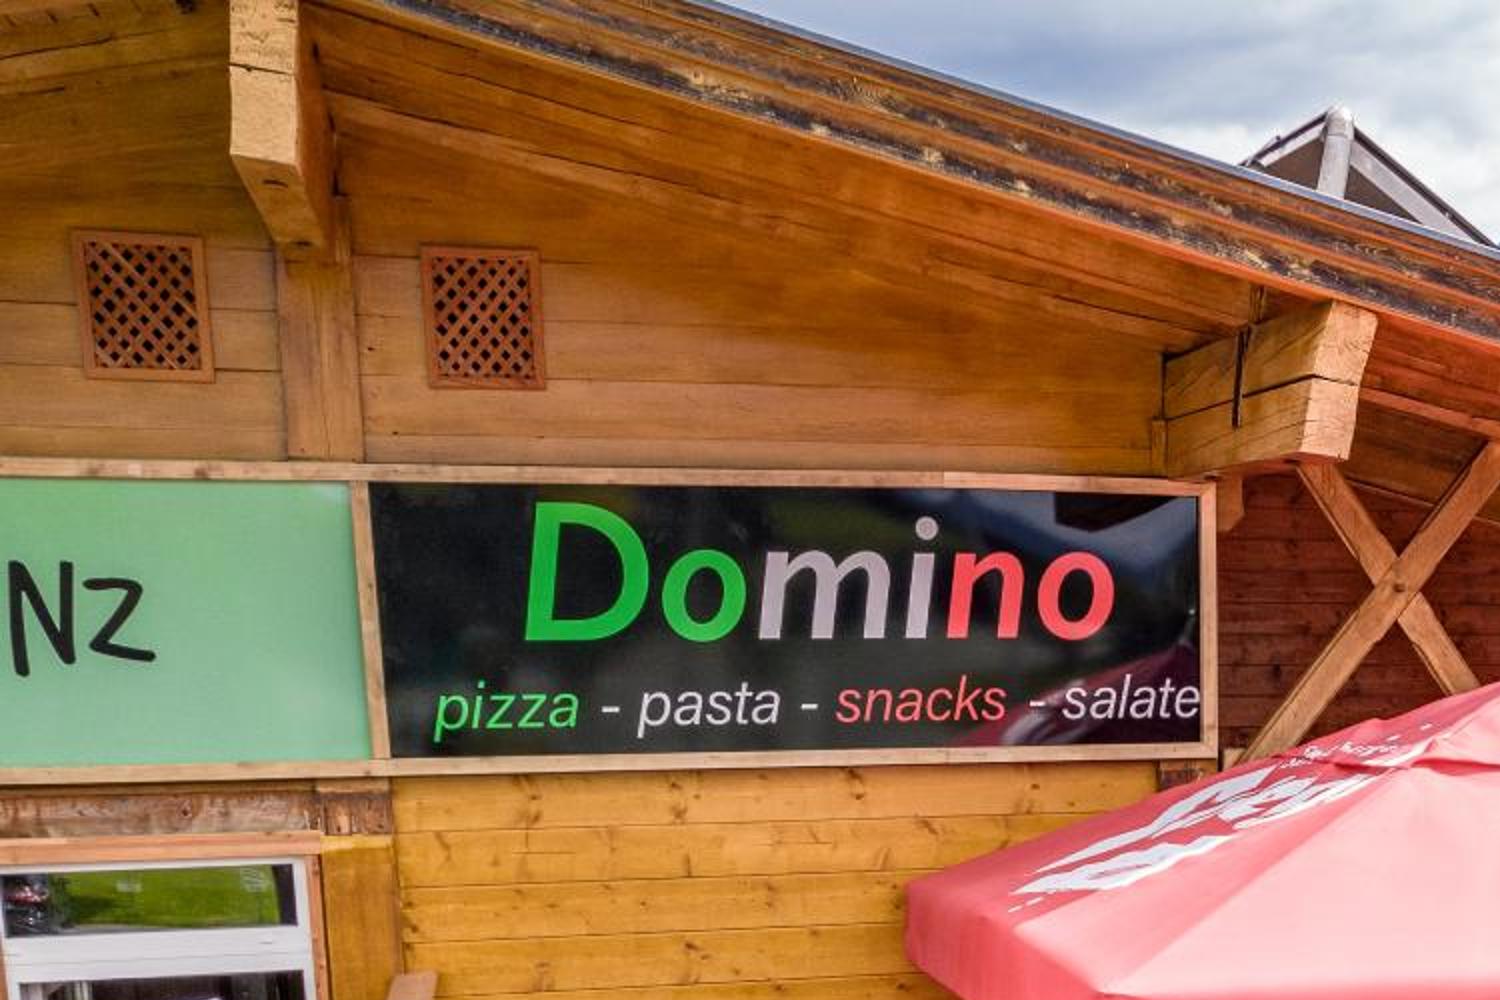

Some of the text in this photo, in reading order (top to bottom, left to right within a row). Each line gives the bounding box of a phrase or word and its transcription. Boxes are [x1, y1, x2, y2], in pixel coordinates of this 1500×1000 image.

[525, 501, 1115, 642] Domino
[433, 681, 579, 742] pizza
[636, 681, 781, 739] pasta
[835, 675, 1006, 723] snacks
[1062, 673, 1200, 720] salate
